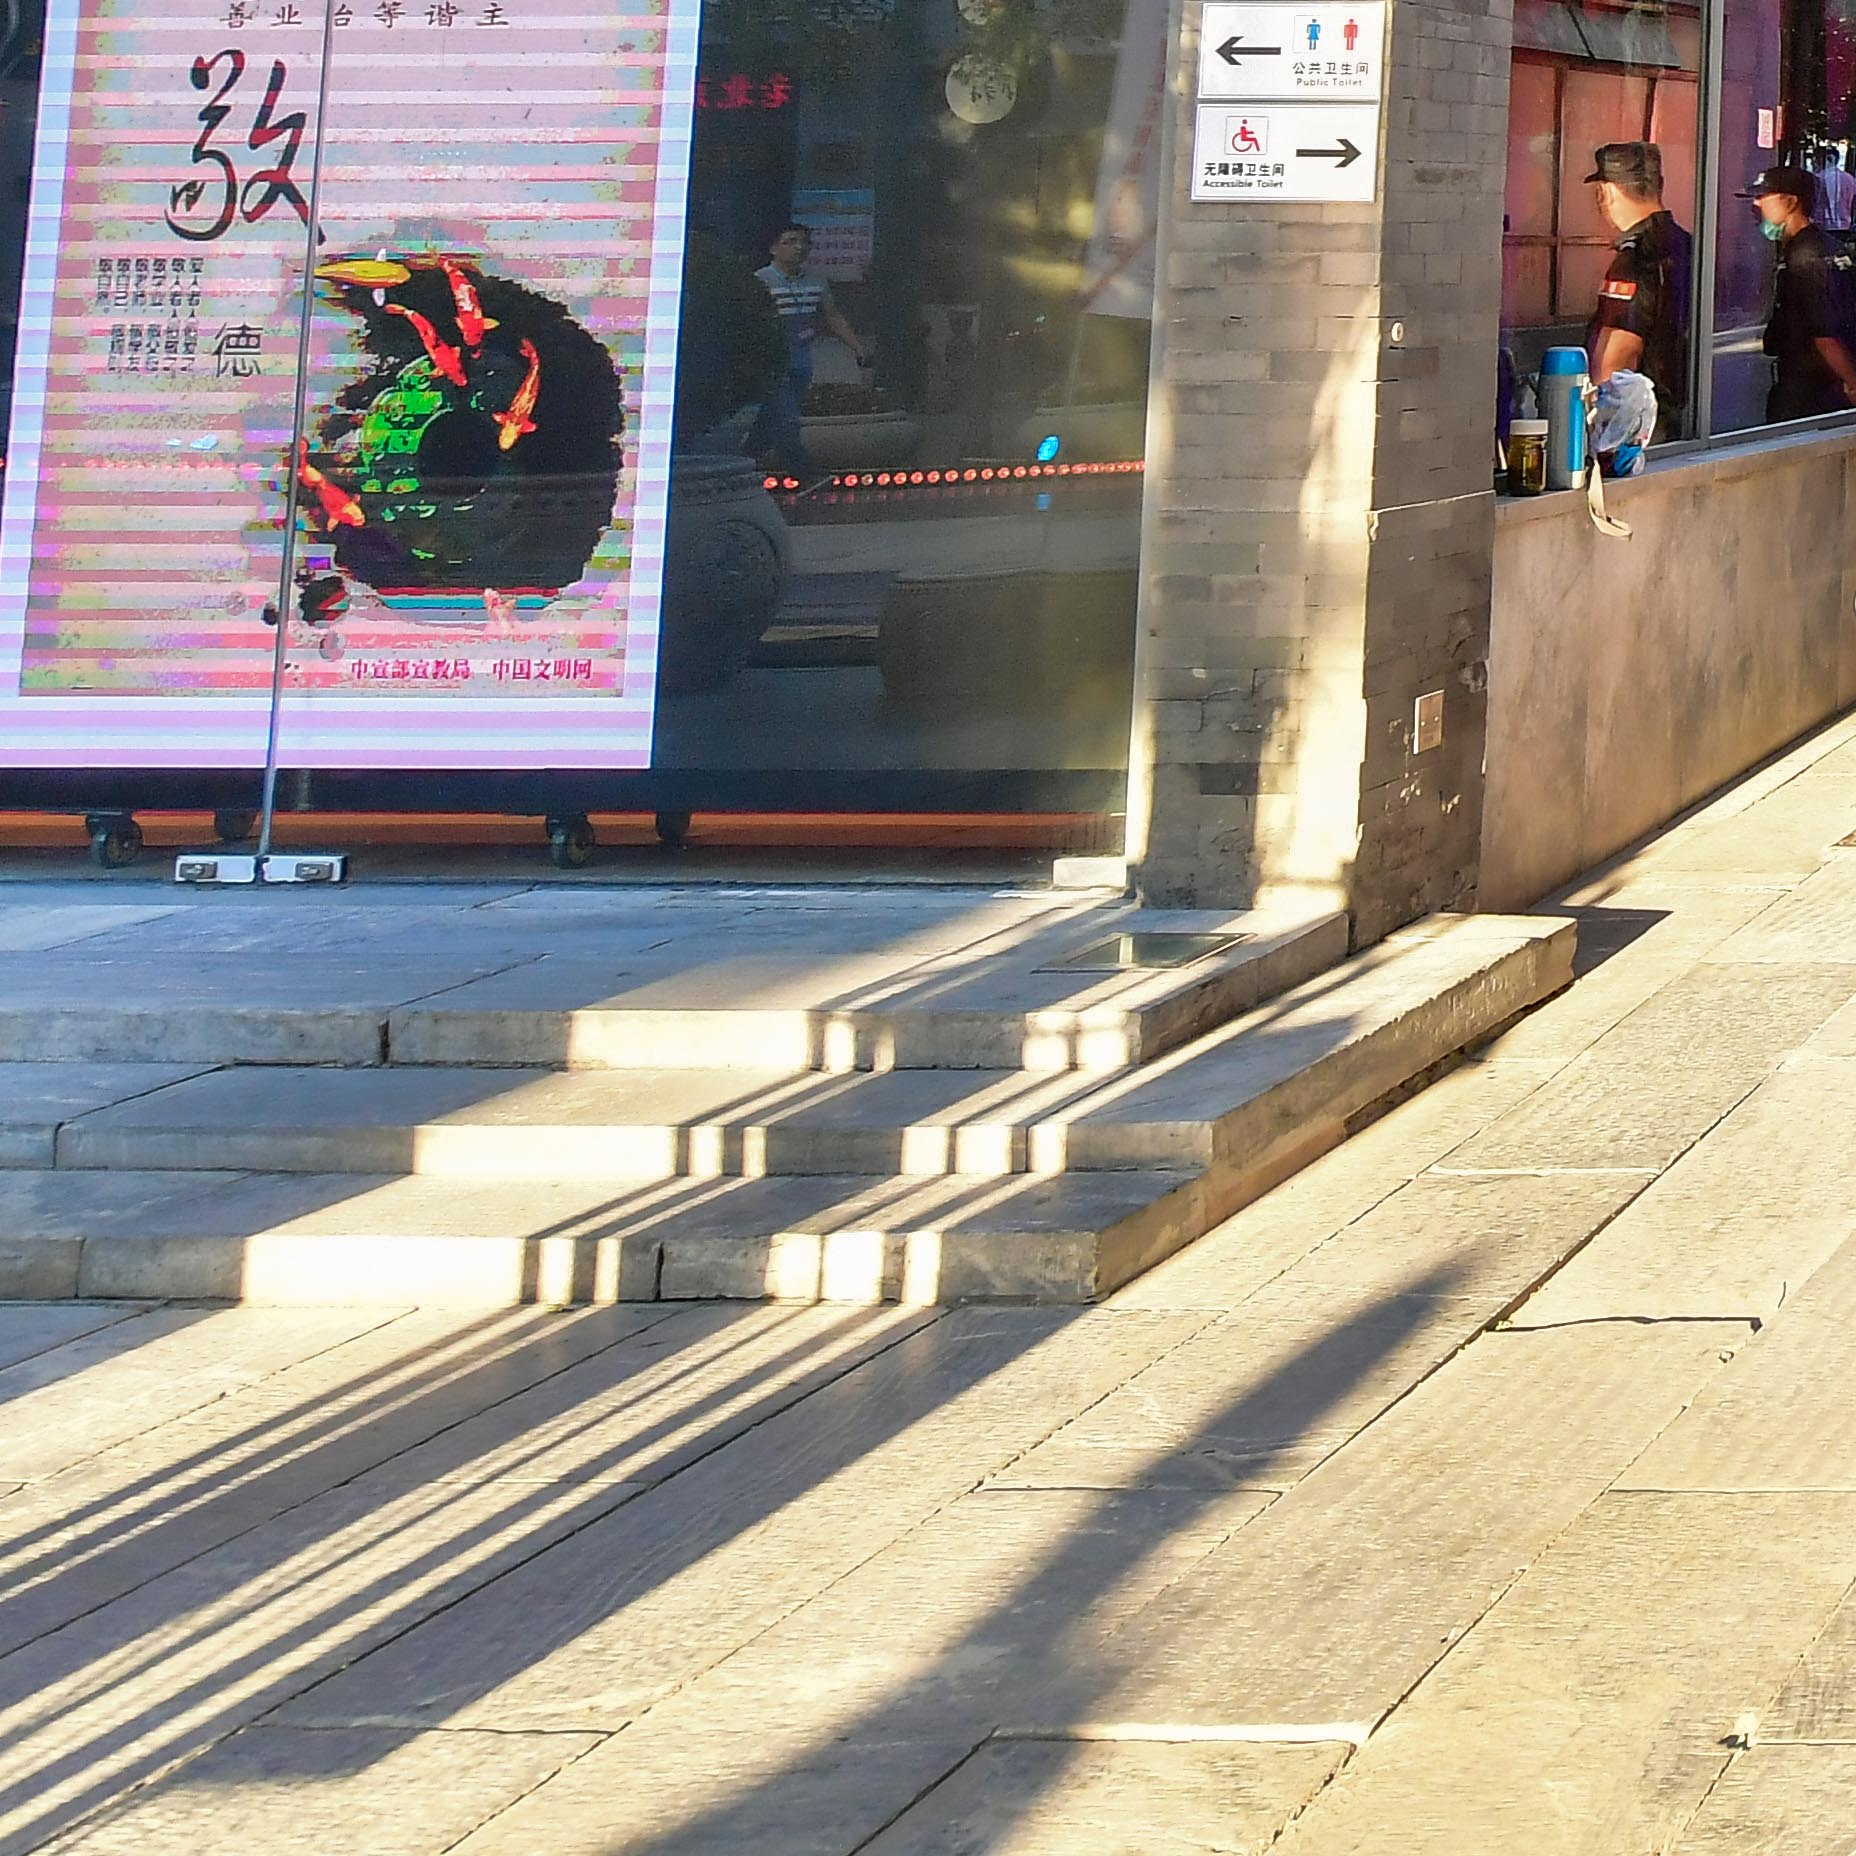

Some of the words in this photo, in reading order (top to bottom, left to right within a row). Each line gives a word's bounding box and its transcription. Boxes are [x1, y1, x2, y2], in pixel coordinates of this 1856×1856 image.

[1292, 62, 1369, 76] 公共卫生间
[1296, 78, 1329, 87] Public
[1333, 78, 1363, 87] Toilet
[1203, 179, 1253, 189] Accessible
[1257, 180, 1284, 189] Toilet
[212, 322, 264, 378] 德
[351, 658, 472, 681] 中宣部宣教局
[492, 658, 593, 681] 中国文明网
